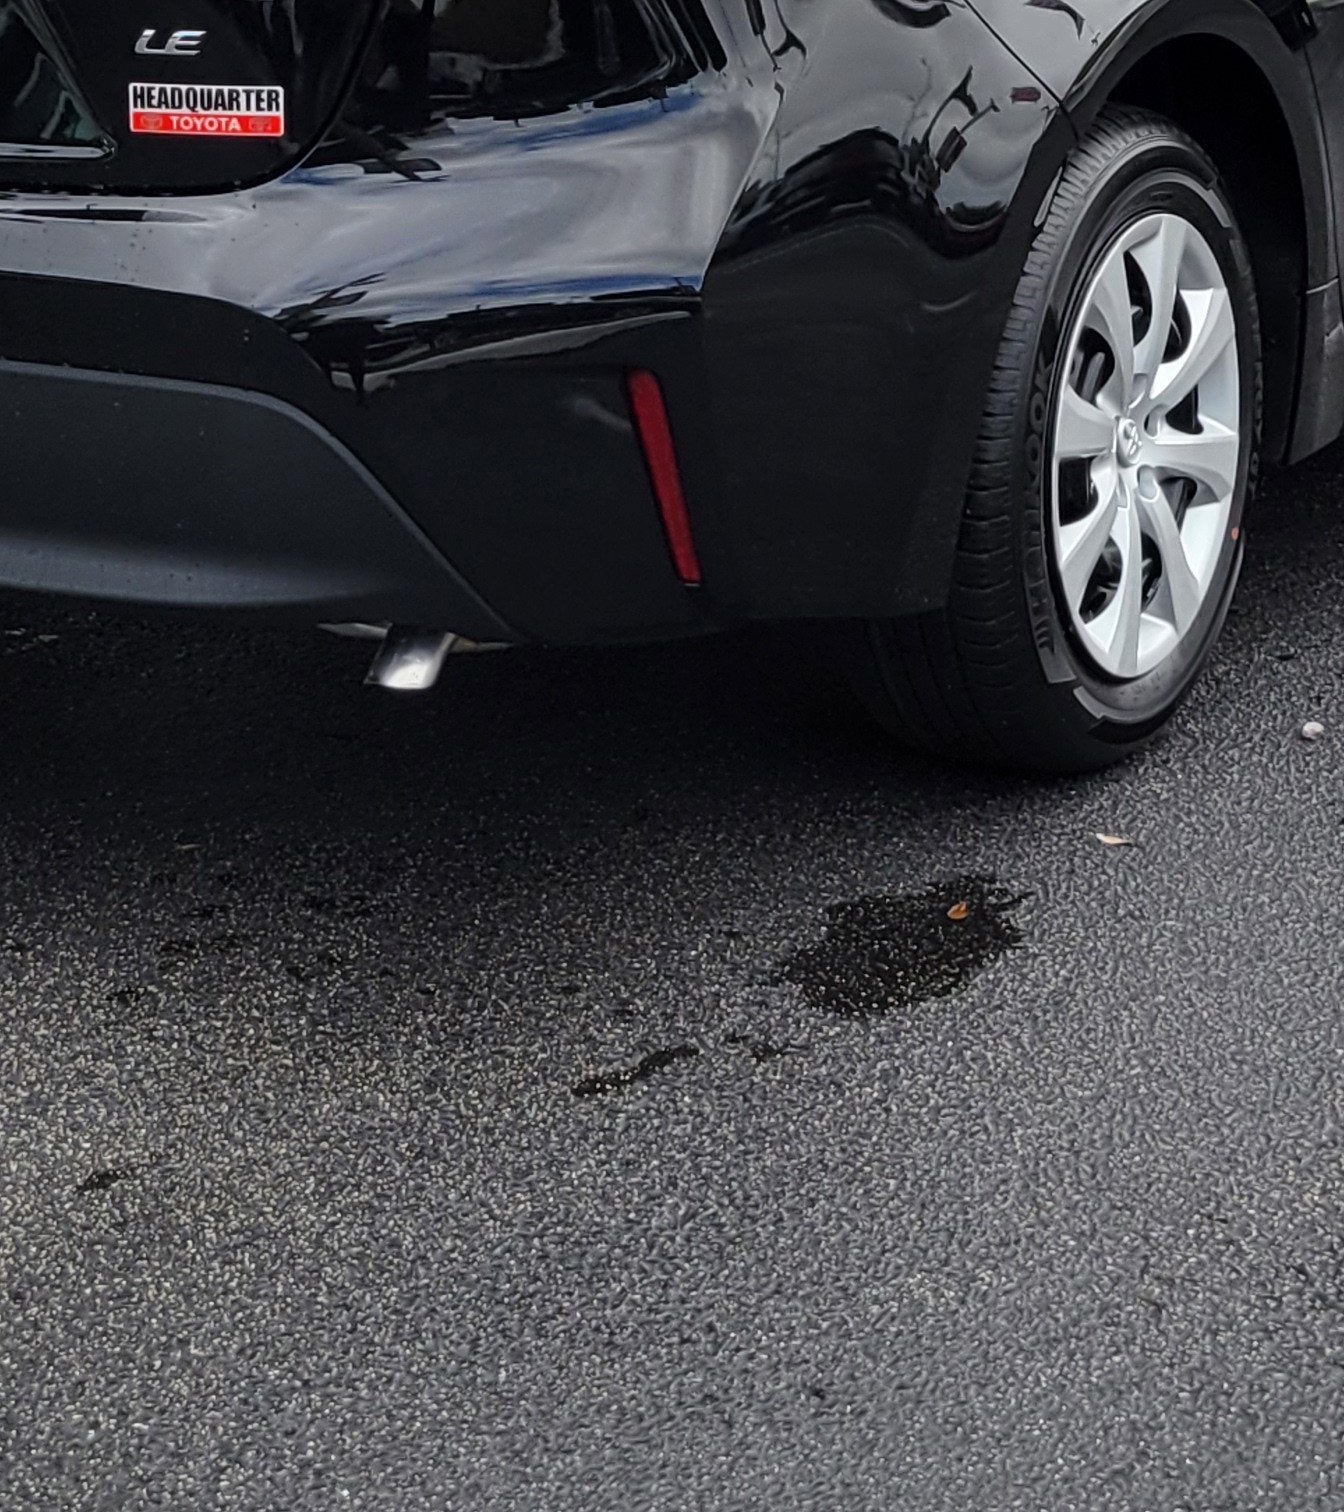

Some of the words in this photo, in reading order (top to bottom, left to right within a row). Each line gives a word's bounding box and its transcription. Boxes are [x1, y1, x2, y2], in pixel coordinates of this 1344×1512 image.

[135, 29, 207, 55] LE
[133, 85, 280, 113] HEADQUARTER
[169, 115, 242, 131] TOYOTA
